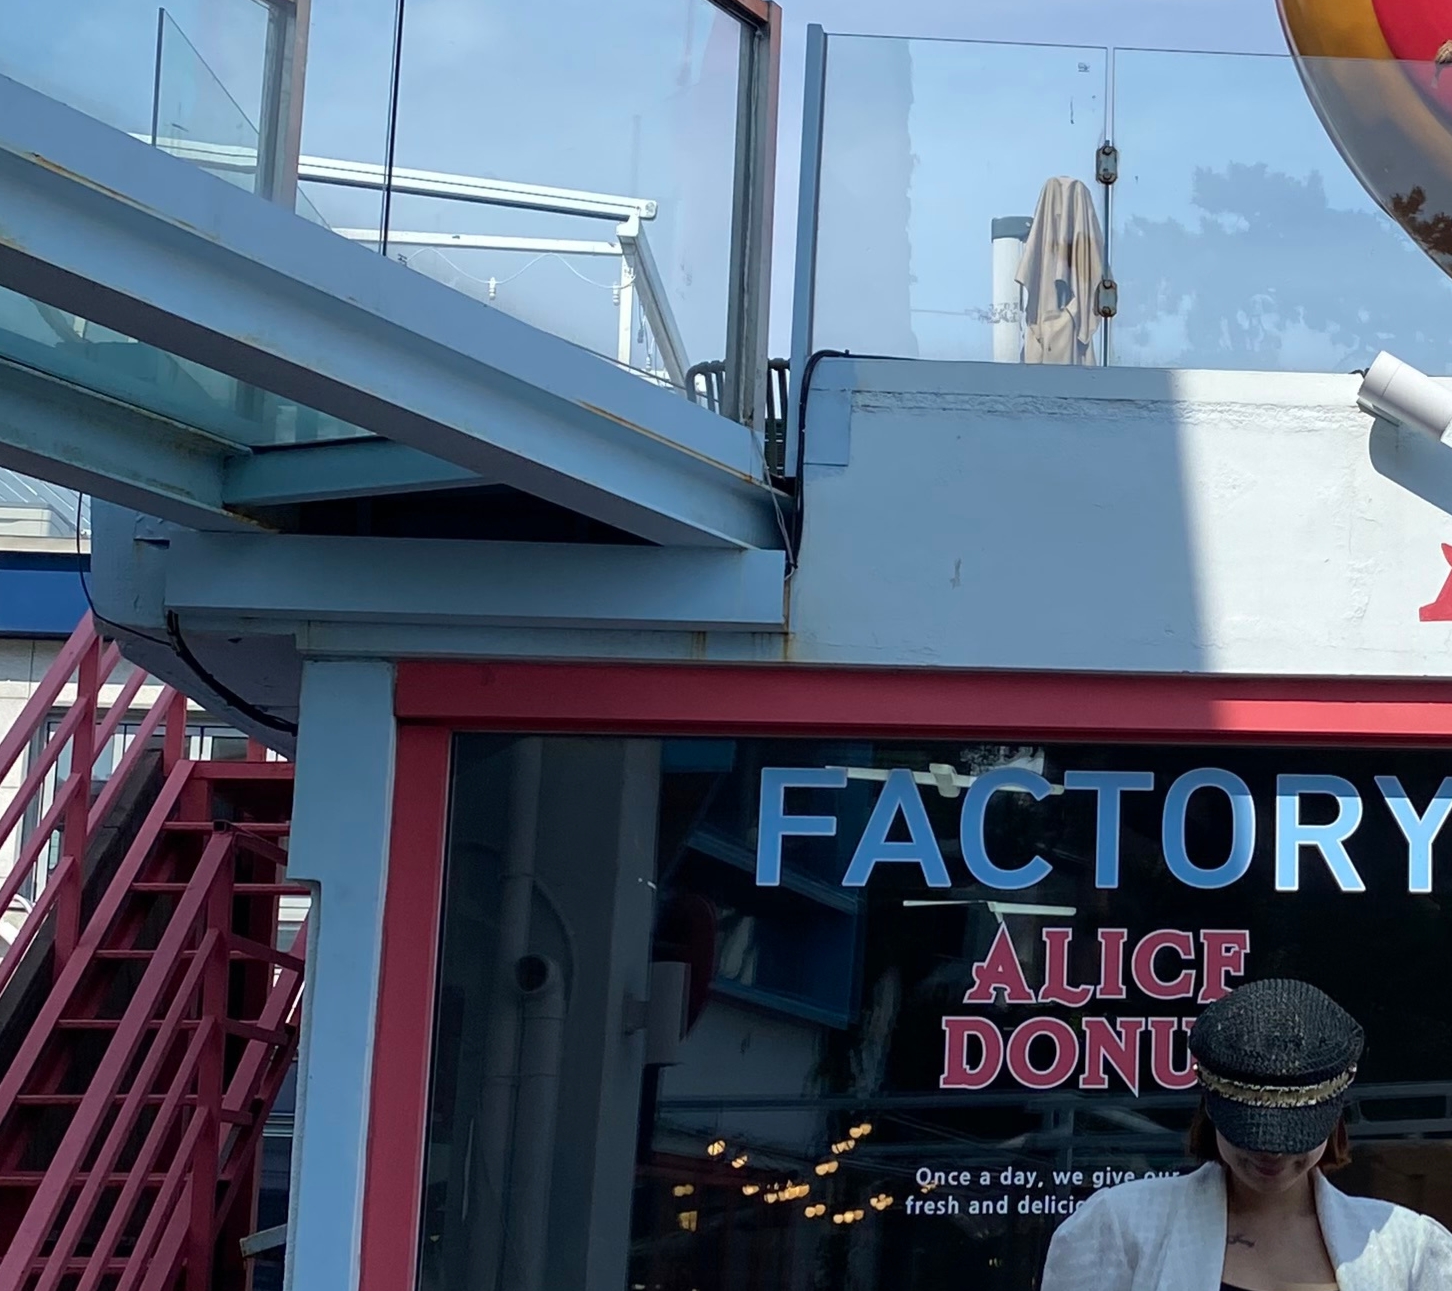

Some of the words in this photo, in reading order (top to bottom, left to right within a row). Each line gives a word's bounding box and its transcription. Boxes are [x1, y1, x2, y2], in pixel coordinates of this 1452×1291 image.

[962, 921, 1250, 1007] ALICE
[939, 1016, 1199, 1098] DONU
[916, 1167, 971, 1186] Once
[980, 1170, 991, 1185] a
[1000, 1166, 1043, 1188] day,
[1052, 1170, 1083, 1185] we
[1092, 1166, 1135, 1188] give
[905, 1195, 959, 1214] fresh
[968, 1195, 1008, 1214] and
